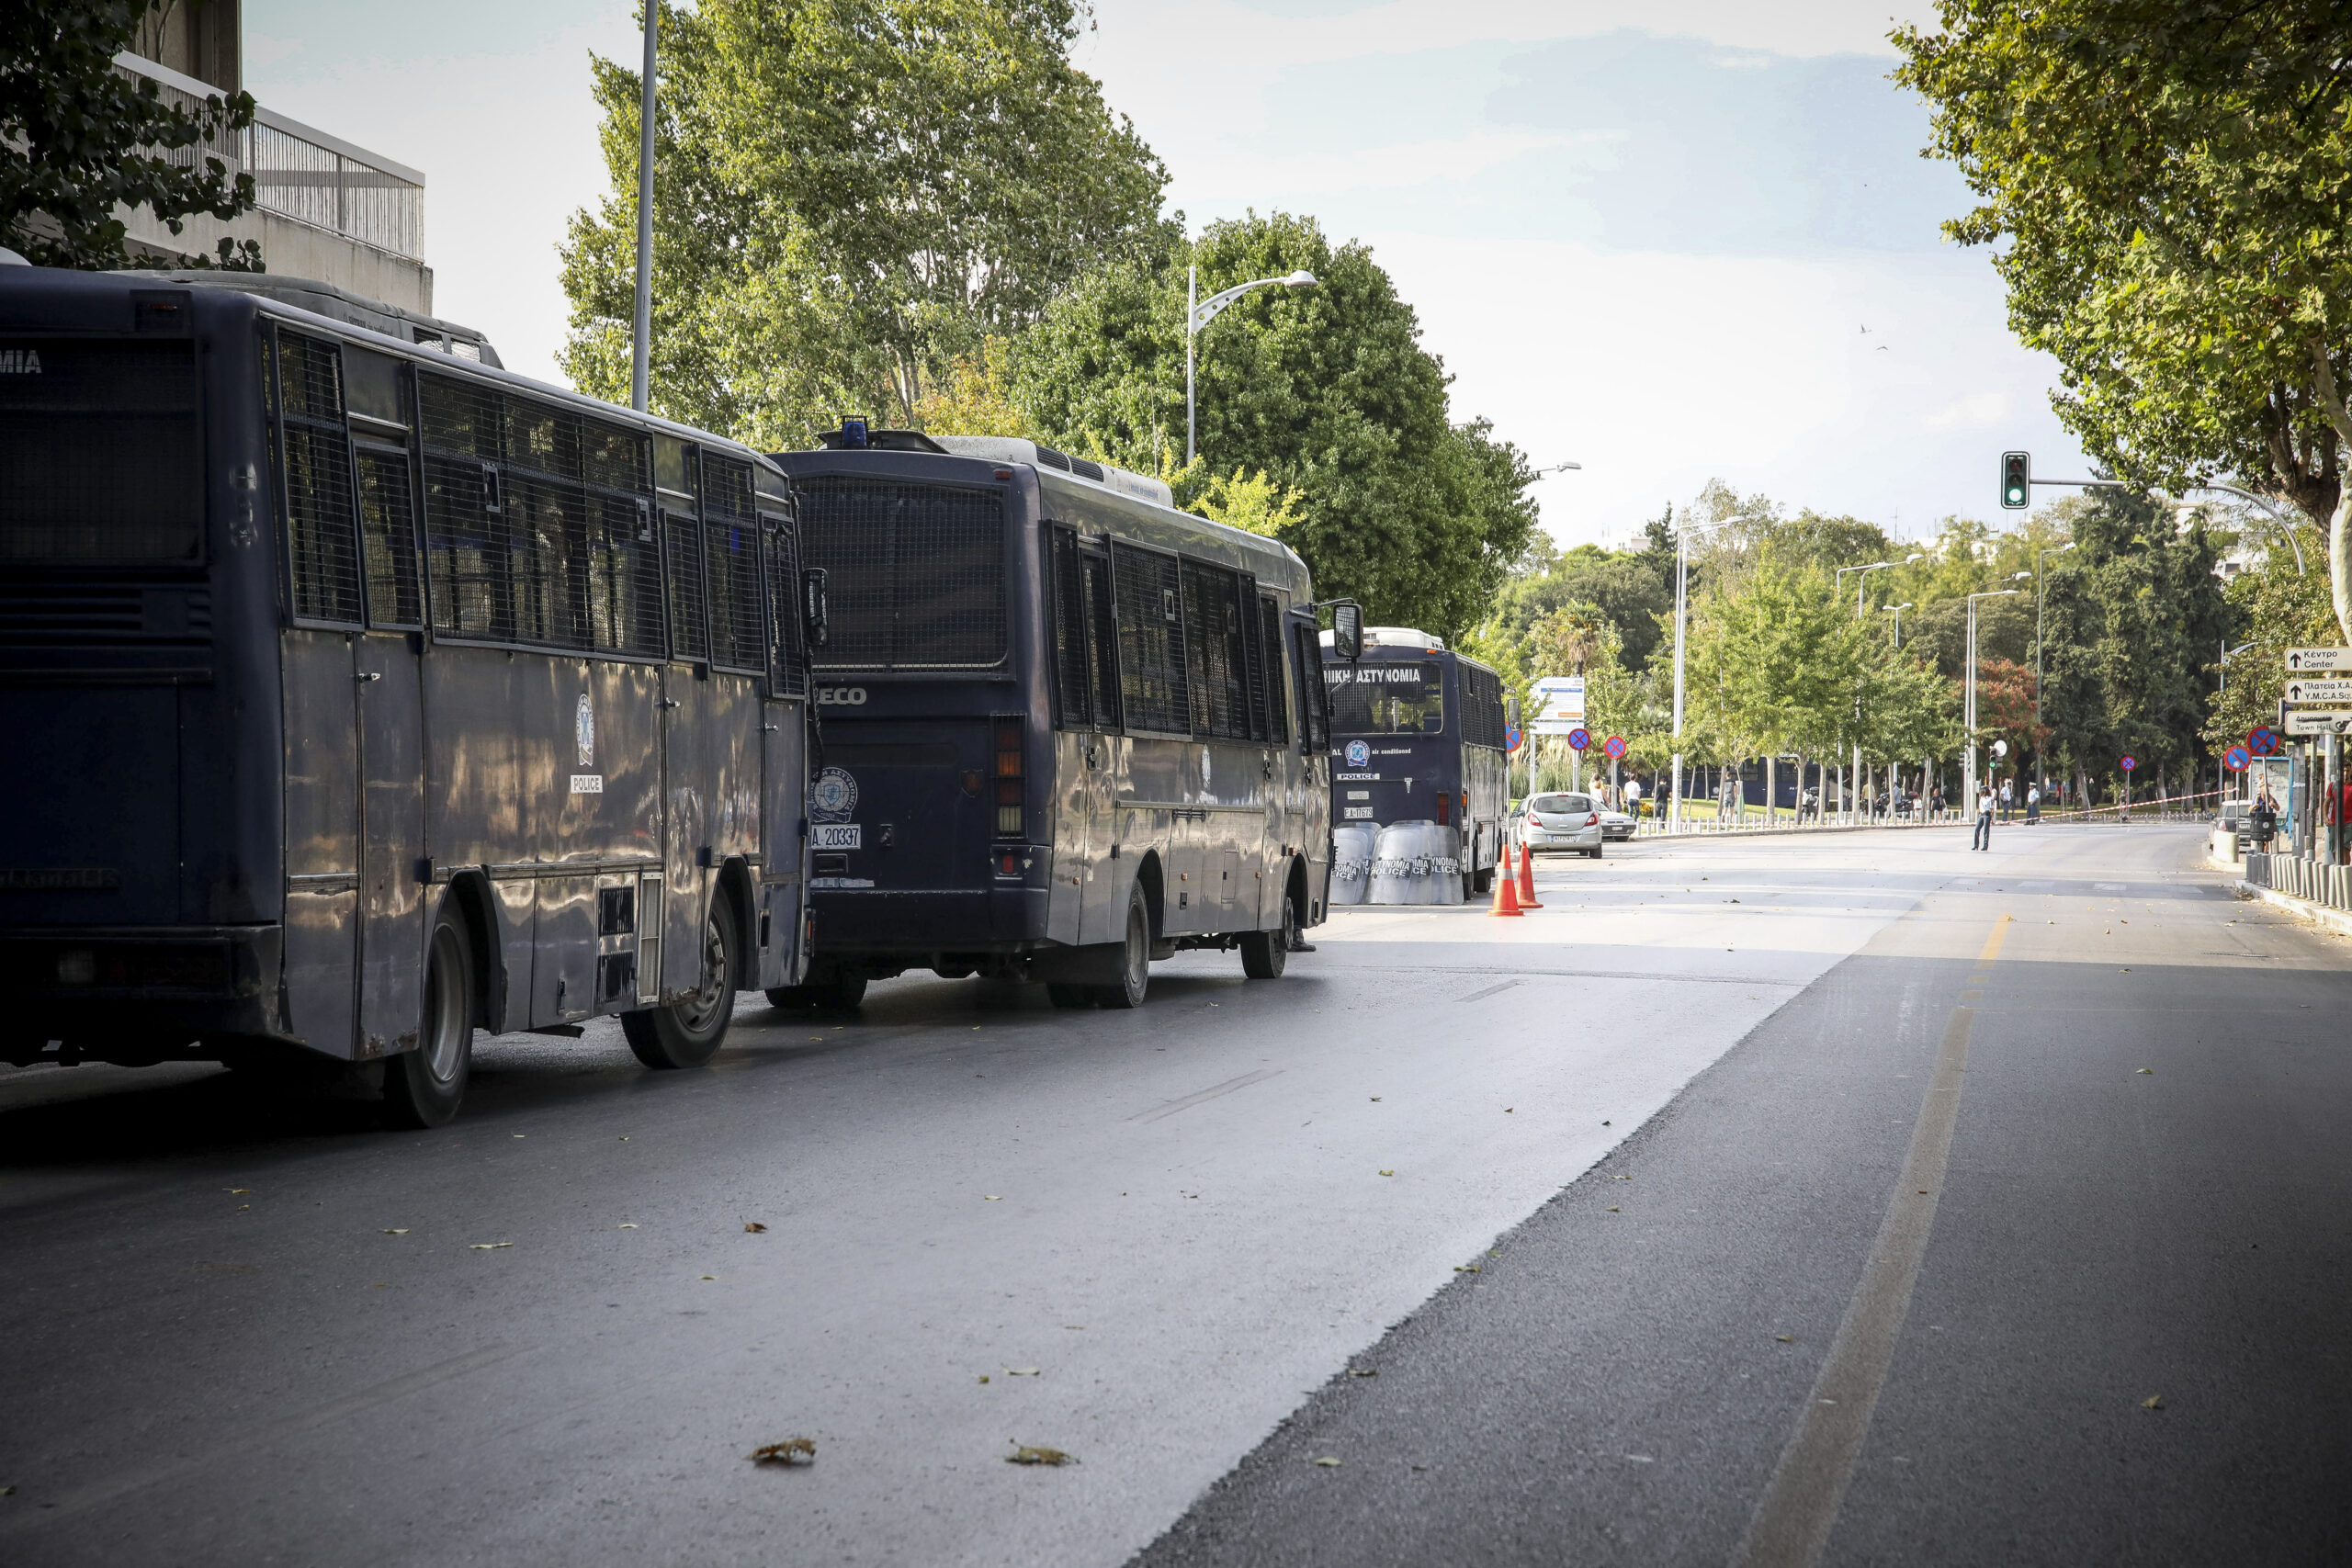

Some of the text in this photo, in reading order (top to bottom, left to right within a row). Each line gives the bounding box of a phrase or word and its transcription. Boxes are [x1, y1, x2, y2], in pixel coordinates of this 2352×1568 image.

[2304, 650, 2337, 659] Κέντρο
[573, 777, 600, 790] POLICE
[1370, 868, 1407, 877] POLICE
